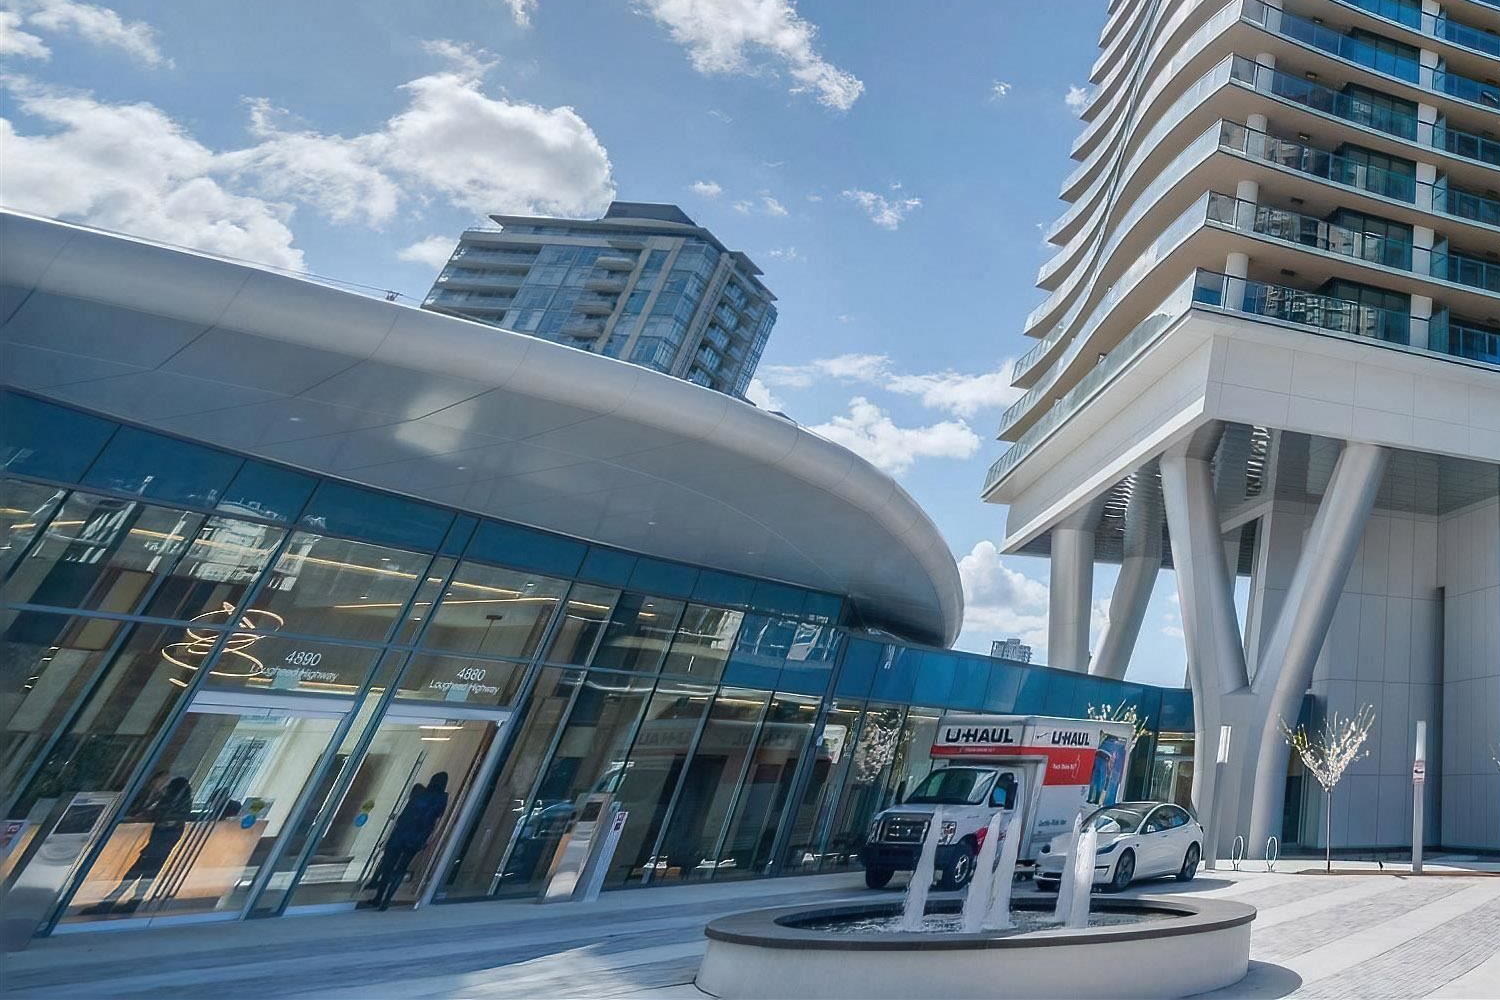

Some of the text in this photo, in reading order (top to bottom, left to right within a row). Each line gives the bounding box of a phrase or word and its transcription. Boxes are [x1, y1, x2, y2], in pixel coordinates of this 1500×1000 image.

[285, 650, 322, 666] 4890
[456, 667, 486, 681] 4880
[945, 728, 1014, 743] U-HAUL
[1051, 730, 1090, 746] U-HAUL
